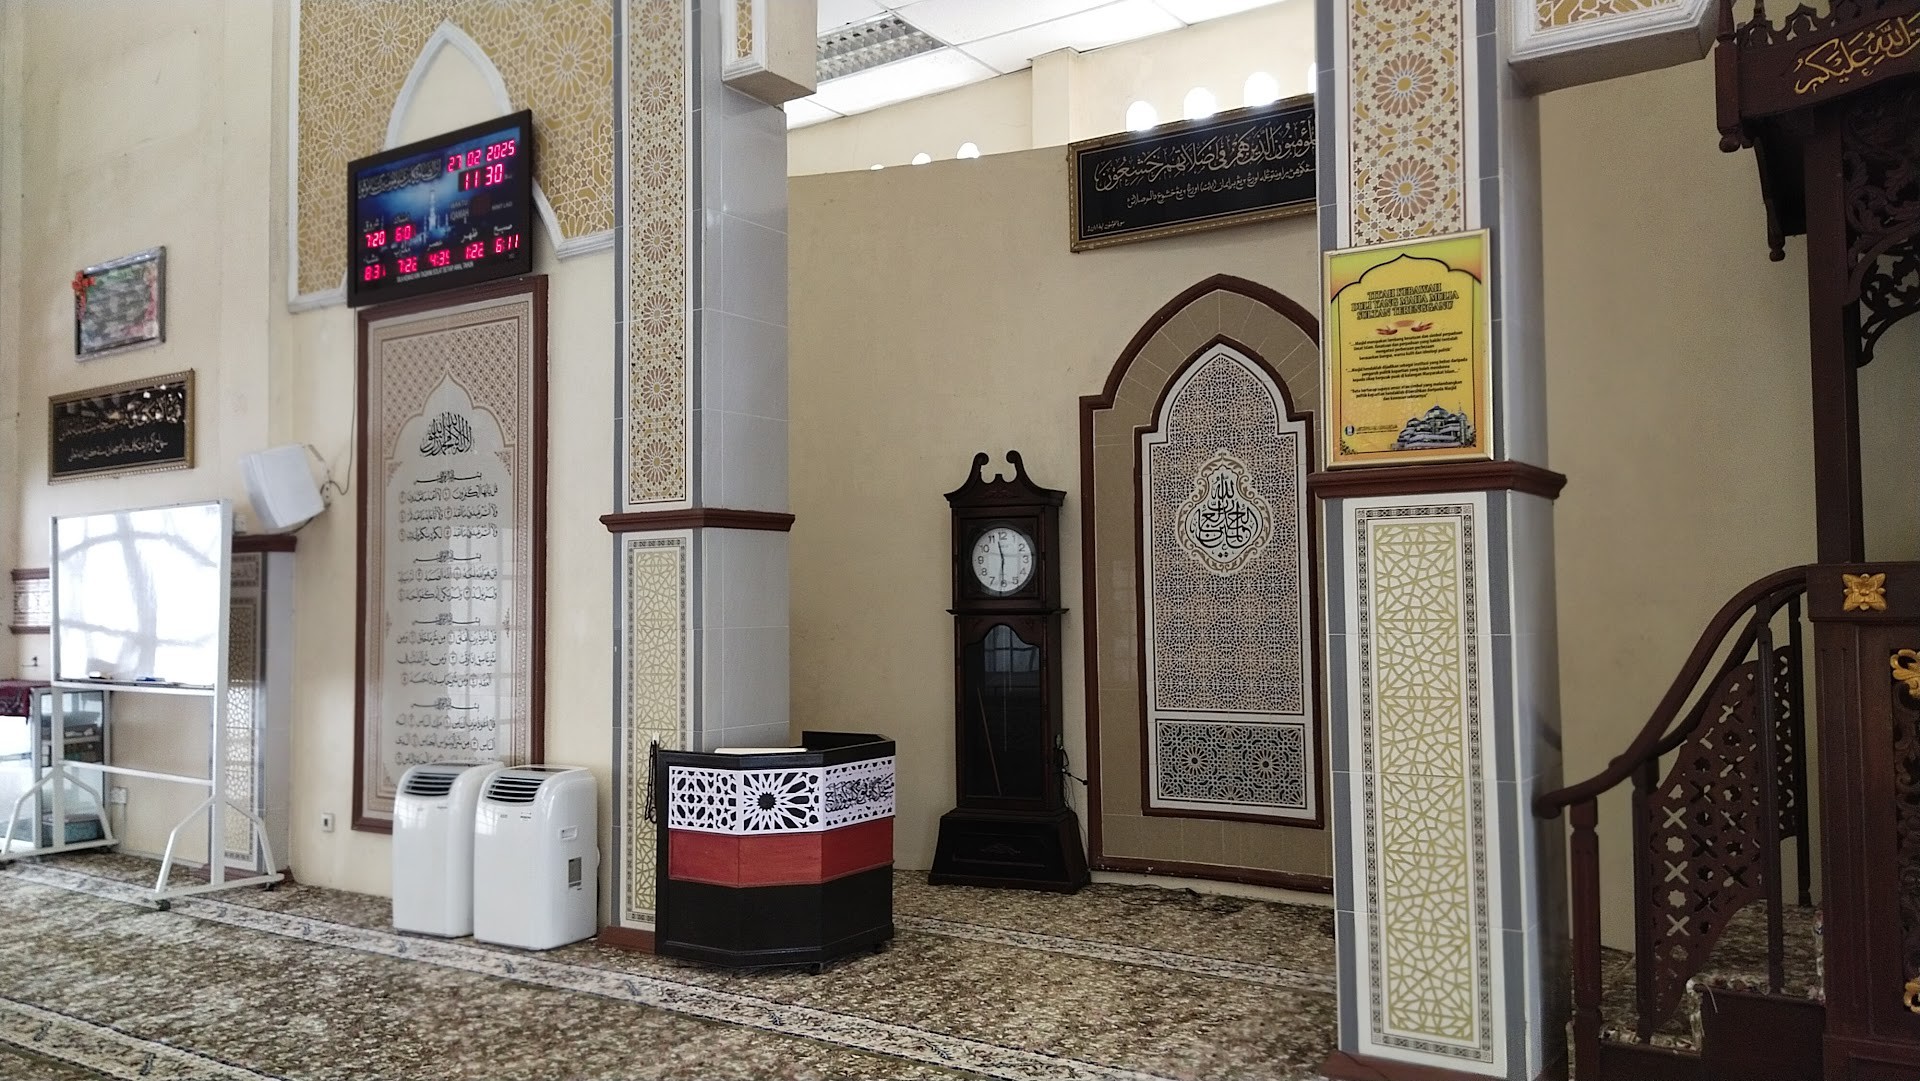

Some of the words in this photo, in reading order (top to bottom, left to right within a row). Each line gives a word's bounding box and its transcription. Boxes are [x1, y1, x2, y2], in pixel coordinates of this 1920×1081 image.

[447, 154, 462, 172] 27
[466, 149, 481, 167] 02
[486, 139, 515, 161] 2025
[464, 170, 479, 190] 11
[485, 163, 503, 186] 30
[1374, 298, 1399, 308] YANG
[1399, 294, 1428, 306] MAHA
[1392, 301, 1454, 316] TERENGGANU
[988, 535, 996, 543] 11
[998, 531, 1008, 540] 12
[1018, 543, 1026, 552] 2
[977, 555, 985, 565] 9
[1022, 554, 1030, 564] 3
[981, 567, 988, 576] 8
[1019, 567, 1027, 576] 4
[989, 576, 996, 586] 7
[1000, 579, 1008, 588] 6
[1012, 576, 1019, 585] 5
